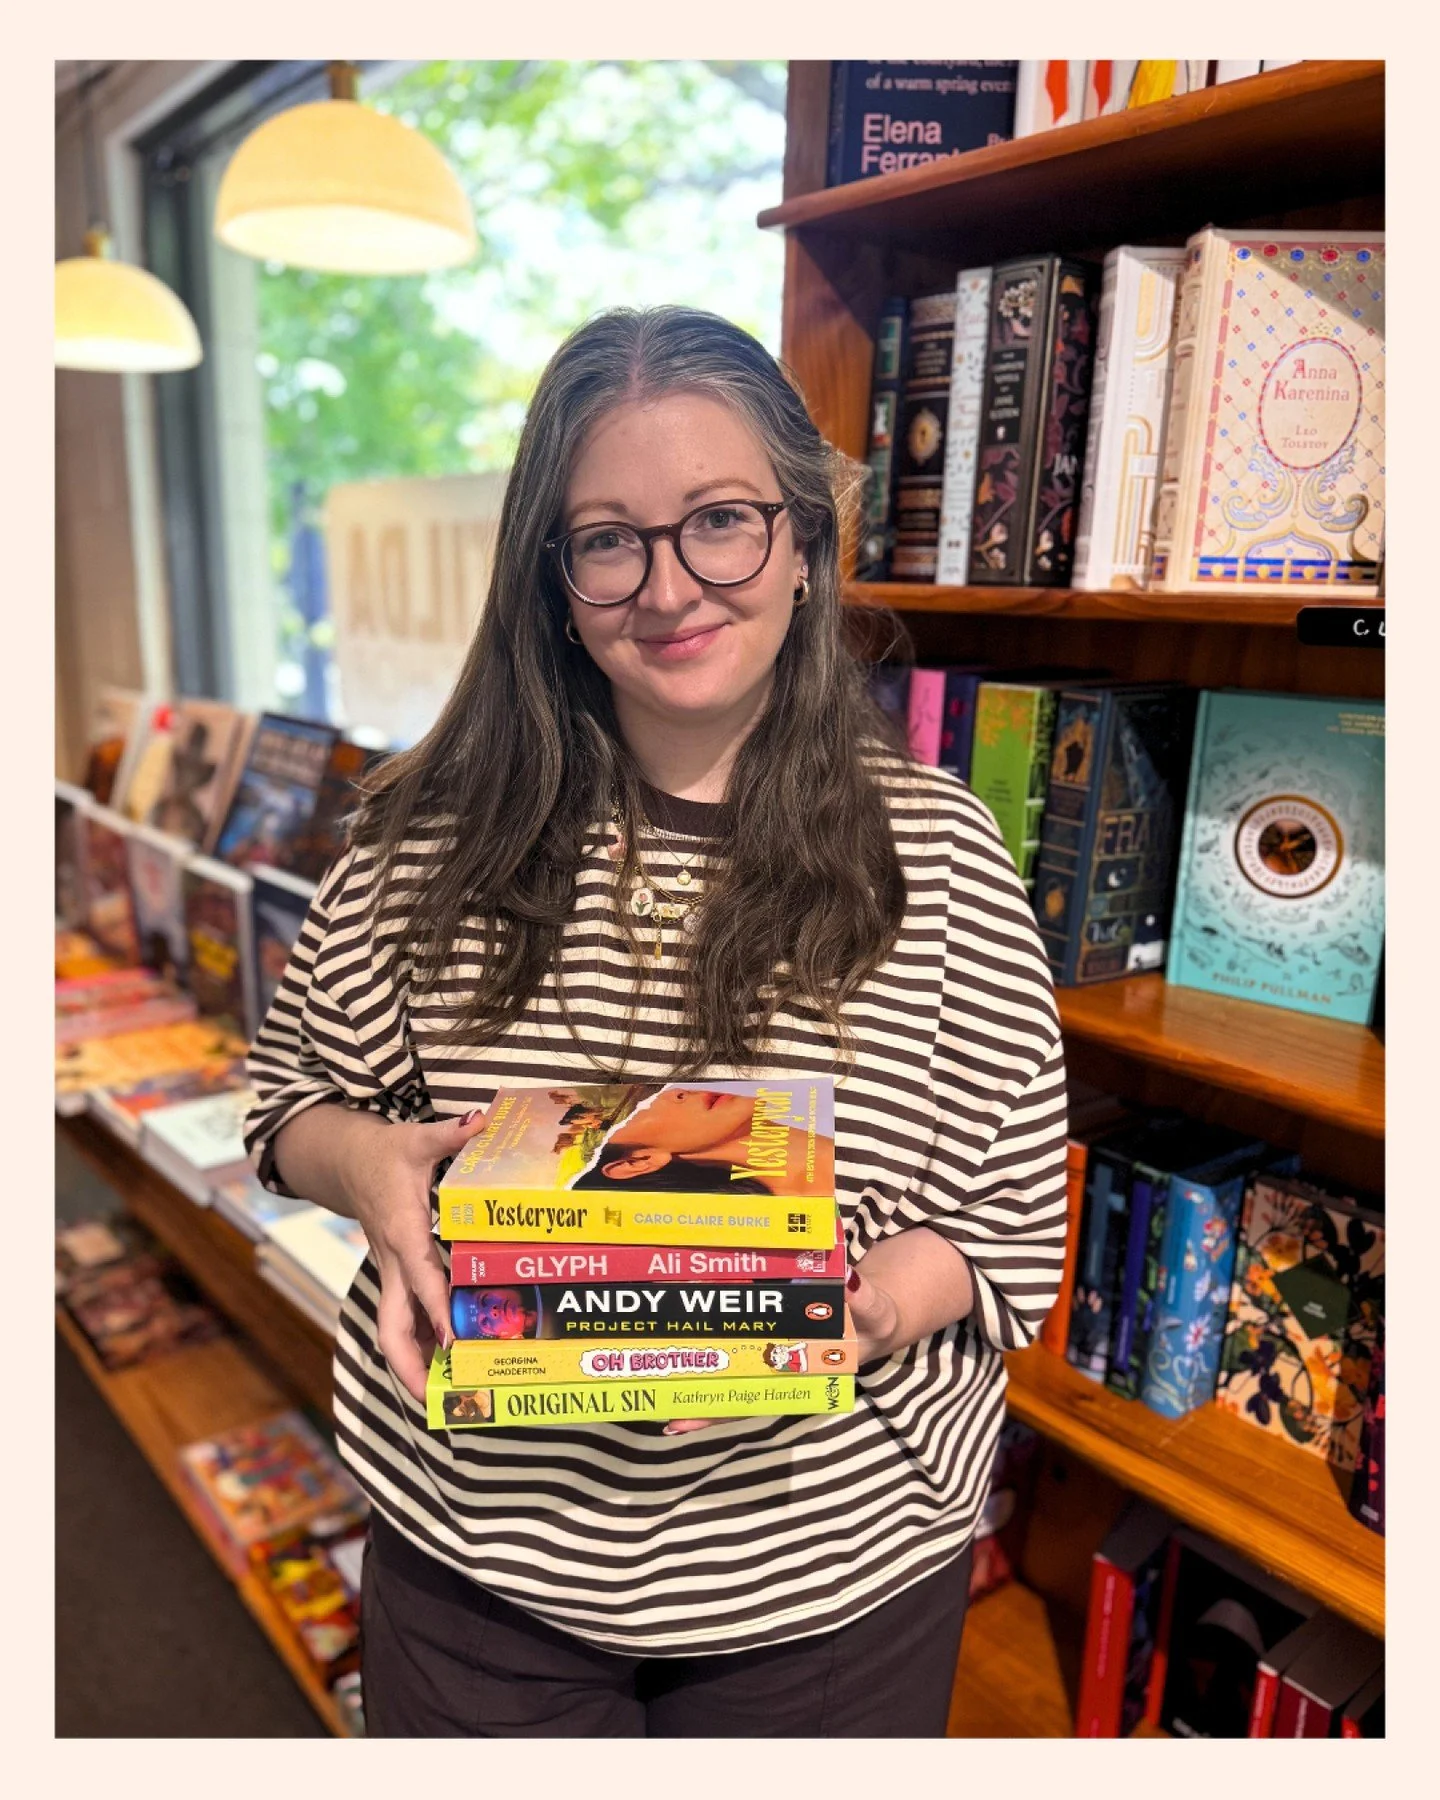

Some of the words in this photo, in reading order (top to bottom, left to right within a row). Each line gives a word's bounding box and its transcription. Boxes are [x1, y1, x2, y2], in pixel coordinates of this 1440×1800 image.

[936, 75, 979, 96] spring
[862, 113, 942, 145] Elena
[1292, 358, 1338, 380] Anna
[1274, 380, 1350, 402] Karenina
[730, 1087, 805, 1181] Yesteryear
[484, 1199, 588, 1234] Yesteryear
[634, 1213, 673, 1225] CARO
[677, 1214, 724, 1226] CLAIRE
[728, 1216, 770, 1228] BURKE
[515, 1255, 608, 1279] GLYPH
[647, 1253, 681, 1274] Ali
[689, 1252, 767, 1274] Smith
[556, 1291, 666, 1314] ANDY
[679, 1290, 783, 1314] WEIR
[566, 1321, 657, 1333] PROJECT
[667, 1321, 714, 1332] HAIL
[723, 1321, 777, 1332] MARY
[487, 1367, 546, 1377] CHADDERTON
[494, 1356, 538, 1367] GEORGINA
[591, 1353, 625, 1372] OH
[629, 1350, 720, 1372] BROTHER
[507, 1391, 614, 1417] ORIGINAL
[621, 1389, 657, 1412] SIN
[672, 1390, 725, 1406] Kathryn
[728, 1389, 761, 1405] Paige
[764, 1387, 811, 1402] Harden
